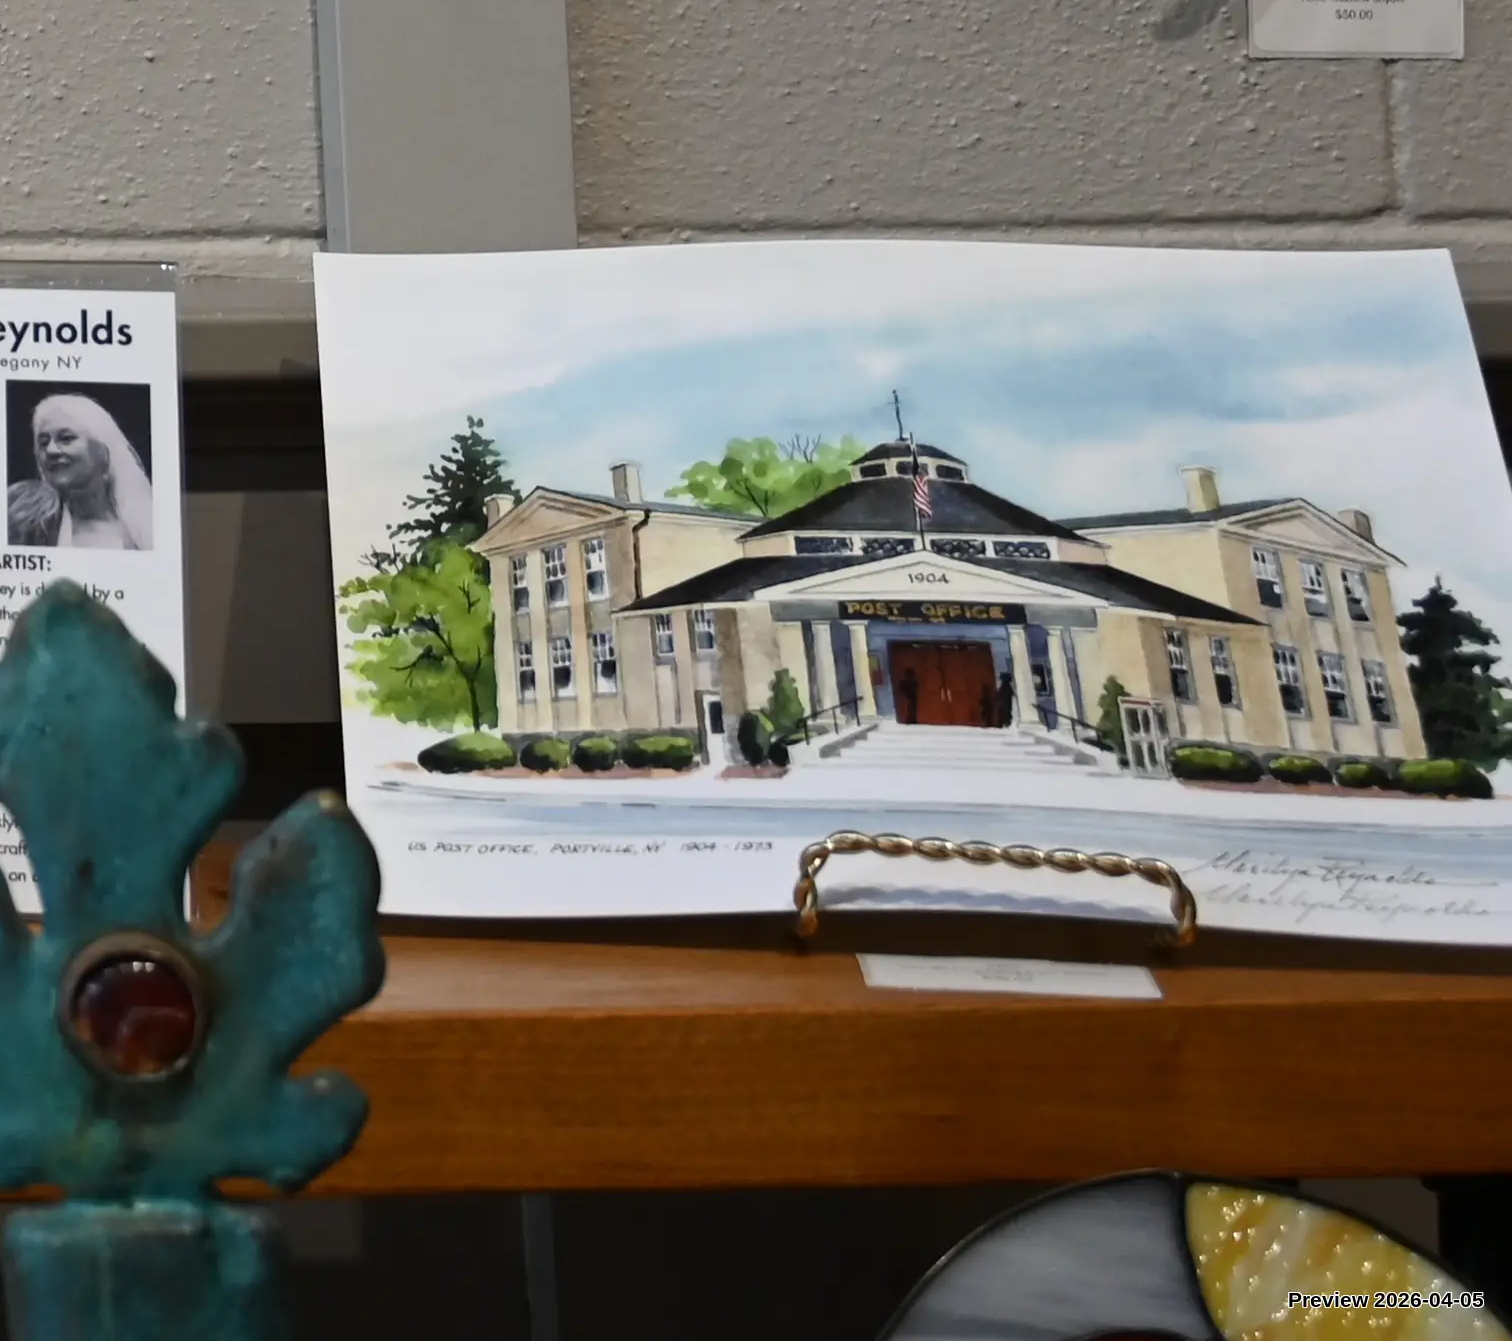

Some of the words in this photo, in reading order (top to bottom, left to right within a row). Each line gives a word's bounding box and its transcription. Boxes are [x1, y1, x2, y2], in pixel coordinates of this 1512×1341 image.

[57, 355, 81, 369] NY
[907, 572, 950, 585] 1904
[845, 601, 903, 616] POST
[920, 603, 1006, 620] OFFICE
[433, 841, 473, 854] POST
